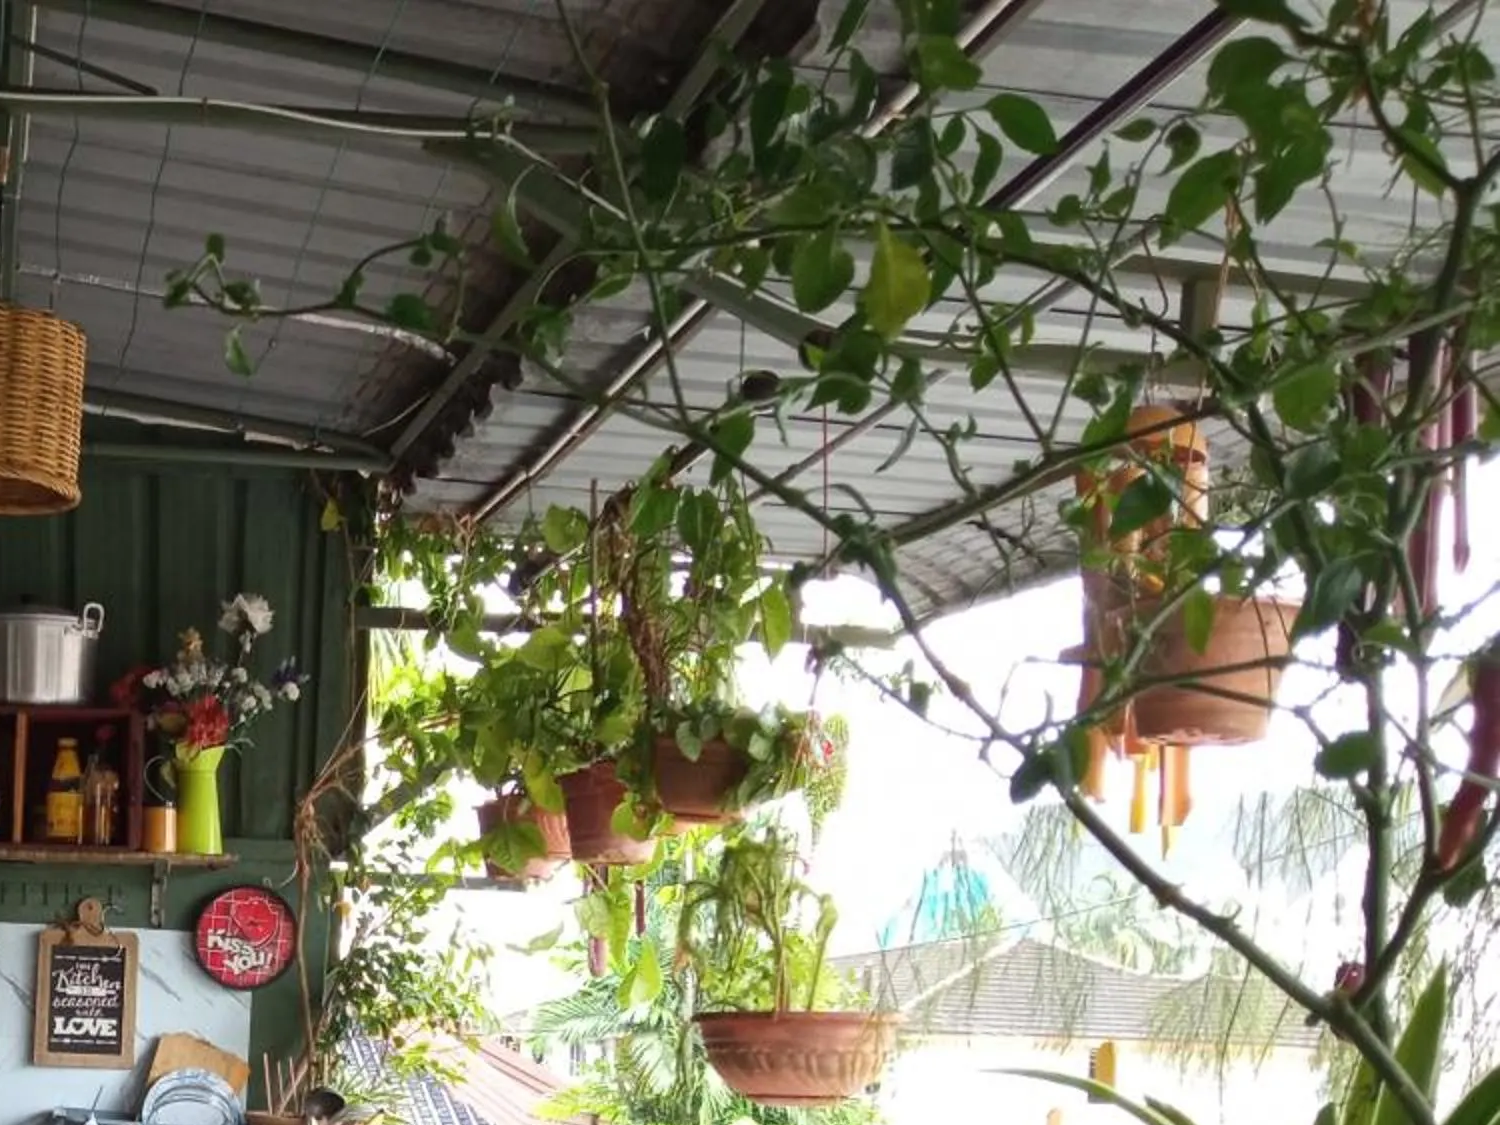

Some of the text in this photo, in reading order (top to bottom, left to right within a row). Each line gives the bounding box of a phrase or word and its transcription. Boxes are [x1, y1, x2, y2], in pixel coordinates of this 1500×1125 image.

[52, 963, 121, 992] Kitchen
[53, 996, 119, 1008] seasoned
[53, 1016, 117, 1036] LOVE
